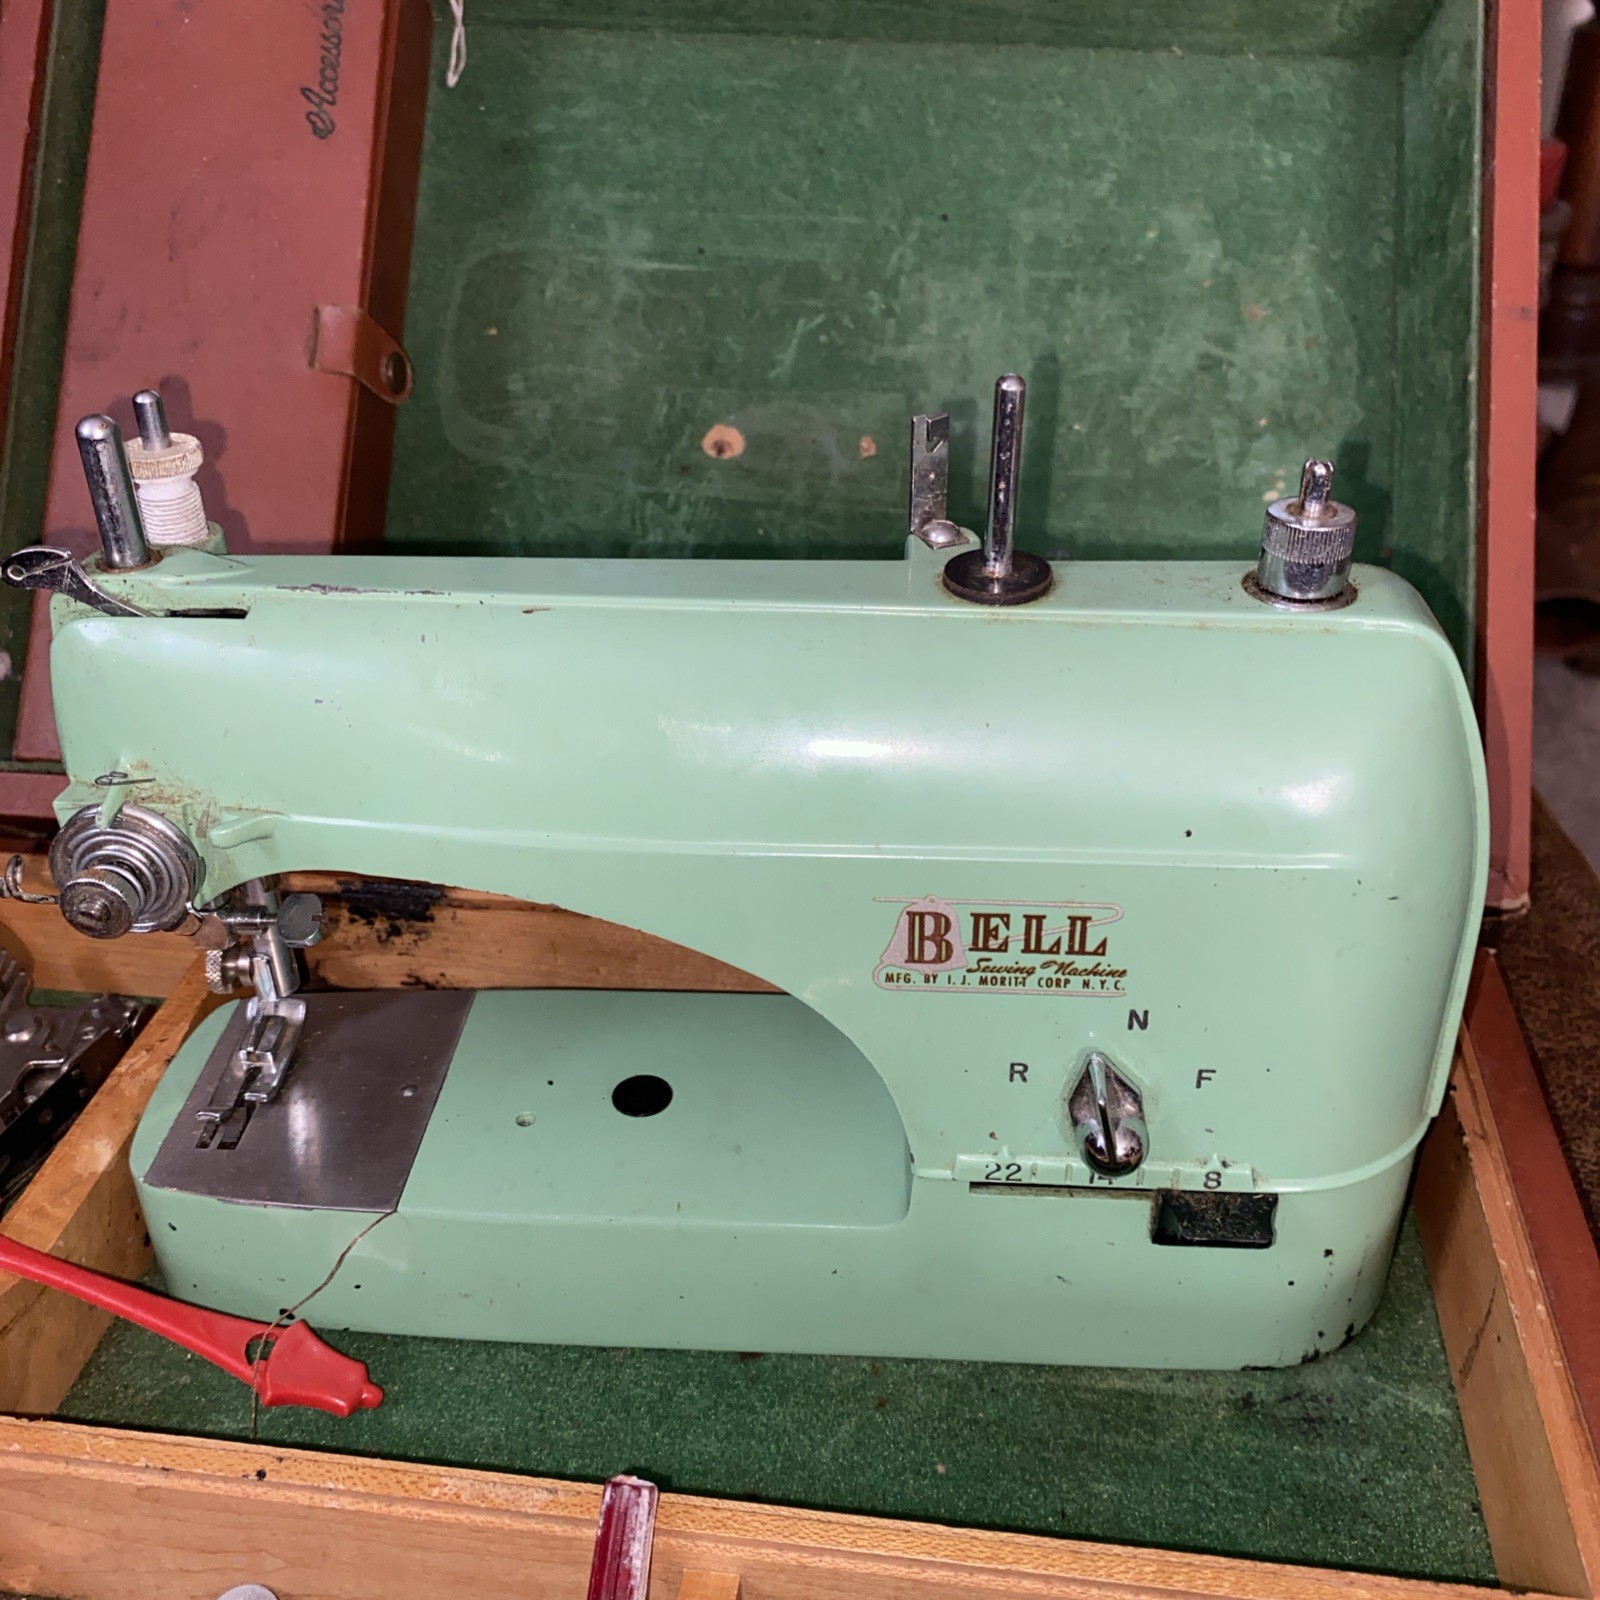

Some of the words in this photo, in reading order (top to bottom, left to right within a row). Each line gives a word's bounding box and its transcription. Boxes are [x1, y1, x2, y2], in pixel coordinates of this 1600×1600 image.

[904, 910, 1108, 964] BELL
[966, 957, 1037, 977] Sewing
[1040, 960, 1128, 978] Machine
[884, 972, 916, 984] MFG.
[923, 973, 939, 984] BY
[978, 975, 1027, 987] MORITT
[1037, 977, 1071, 989] CORP
[1127, 1009, 1149, 1031] N
[1008, 1062, 1029, 1083] R
[1195, 1069, 1217, 1089] F
[984, 1163, 1023, 1182] 22
[1203, 1171, 1222, 1189] 8
